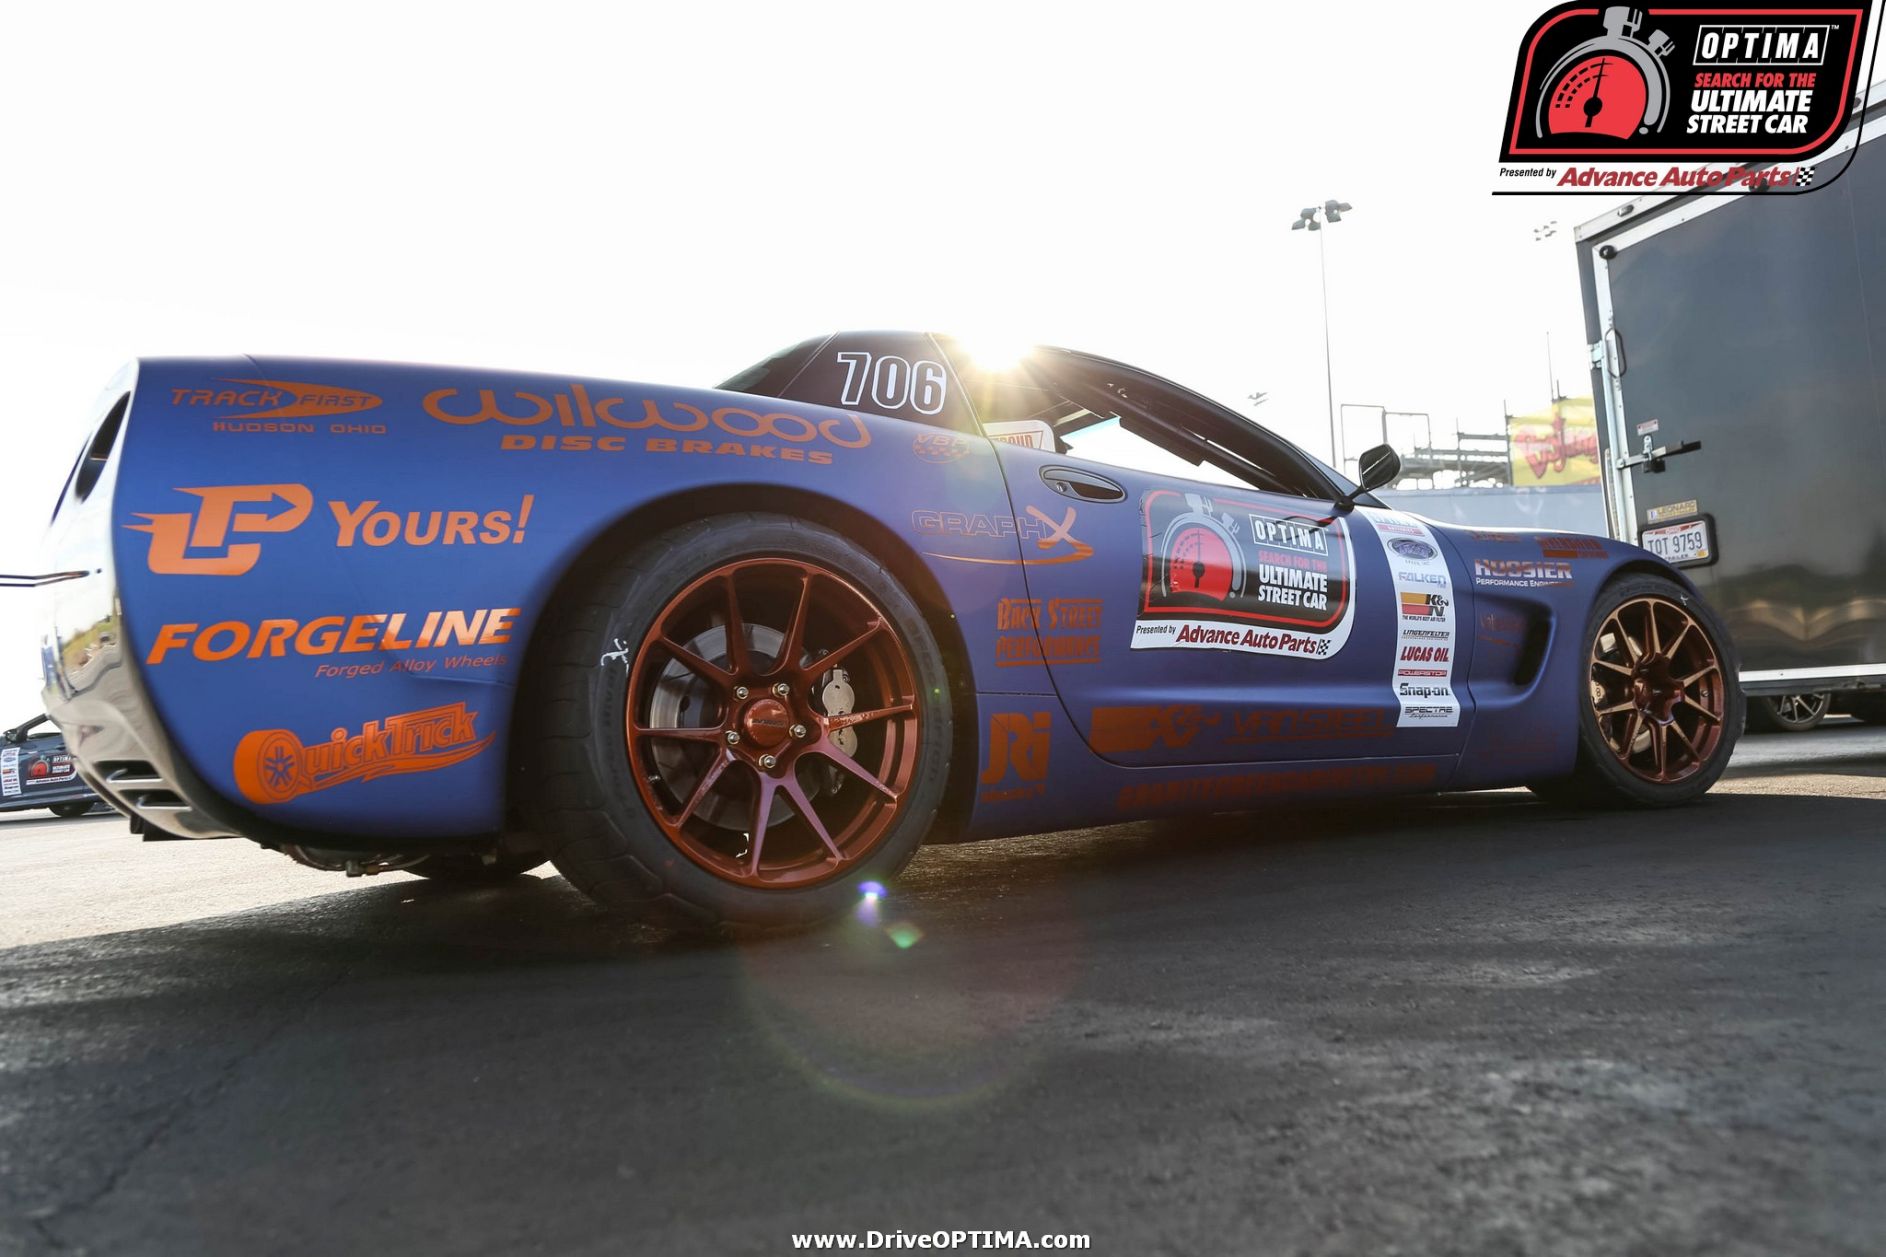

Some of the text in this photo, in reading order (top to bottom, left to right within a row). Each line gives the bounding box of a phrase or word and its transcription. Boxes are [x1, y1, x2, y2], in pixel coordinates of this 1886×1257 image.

[837, 352, 947, 415] 706
[170, 389, 373, 406] TRACK FIRST
[212, 422, 387, 434] HUDSON OHIO
[501, 434, 834, 464] DISC BRAKES
[1254, 519, 1325, 551] OPTIMA
[1672, 531, 1703, 553] 9759
[1259, 563, 1328, 592] ULTIMATE
[1475, 558, 1573, 579] HOOSIER
[1257, 584, 1327, 611] STREET CAR
[1425, 593, 1450, 617] K&N
[145, 606, 522, 665] FORGELINE
[1136, 624, 1317, 654] Presented by Advance Auto Parts
[315, 653, 509, 679] Forged Alloy Wheels
[1400, 646, 1450, 662] LUCAS OIL
[1400, 682, 1449, 698] Snap-on
[1405, 706, 1453, 714] SPECTRE
